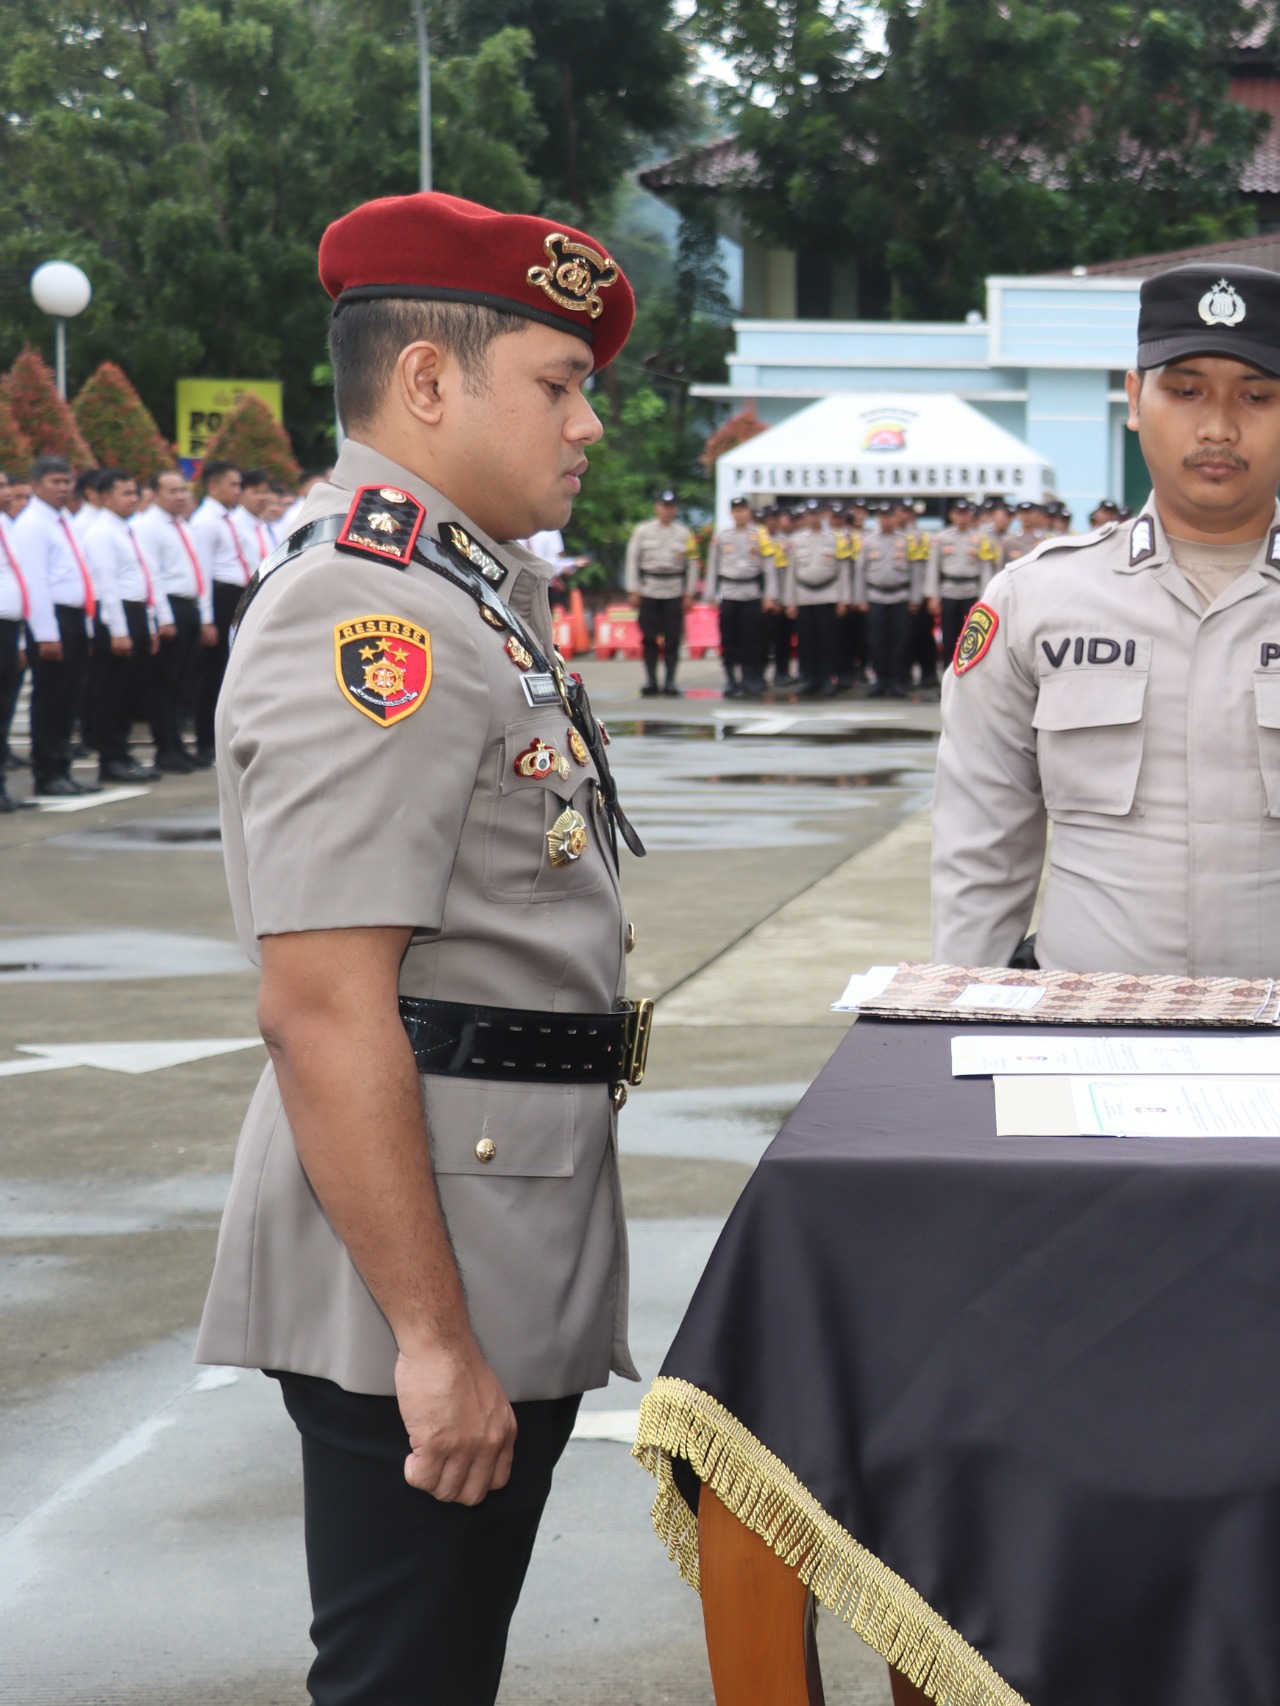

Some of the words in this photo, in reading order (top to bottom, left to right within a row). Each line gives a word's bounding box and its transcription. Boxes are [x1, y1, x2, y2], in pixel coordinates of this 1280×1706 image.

[734, 467, 860, 486] POLRESTA
[877, 467, 1025, 486] TANGERANG
[342, 621, 423, 642] RESERSE
[1041, 636, 1136, 669] VIDI
